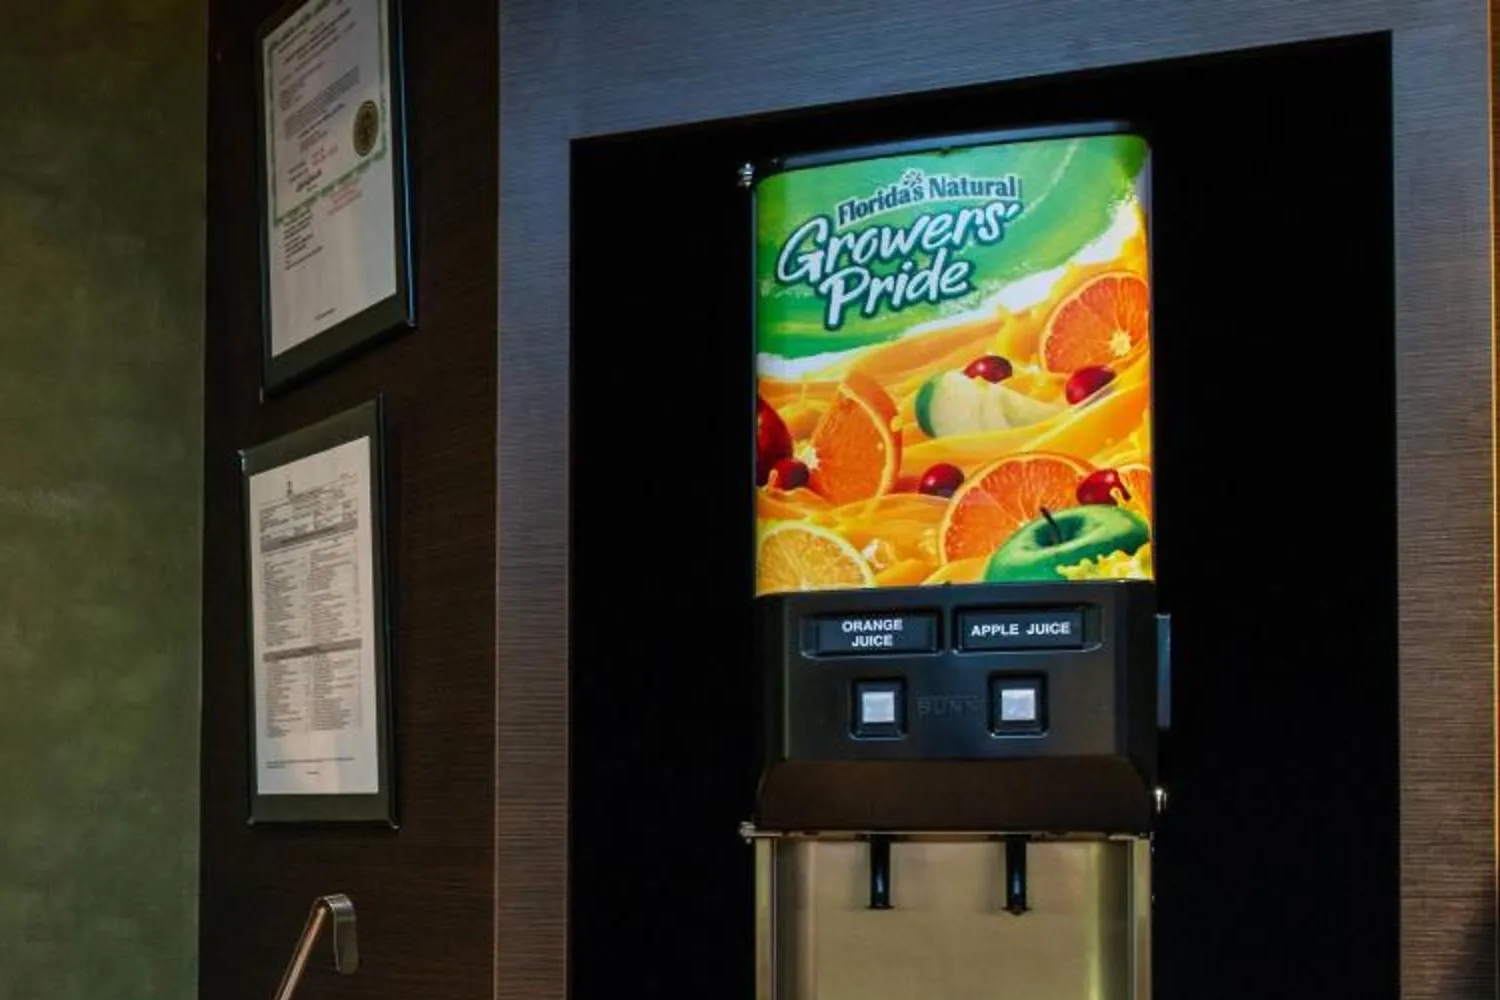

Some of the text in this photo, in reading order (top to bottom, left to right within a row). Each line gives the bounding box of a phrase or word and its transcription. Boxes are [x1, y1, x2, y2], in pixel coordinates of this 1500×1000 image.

[838, 171, 1017, 225] Florida's Natural
[777, 200, 1023, 284] Growers'
[820, 248, 975, 329] Pride
[841, 619, 903, 633] ORANGE
[851, 634, 893, 647] JUICE
[971, 620, 1071, 636] APPLE JUICE
